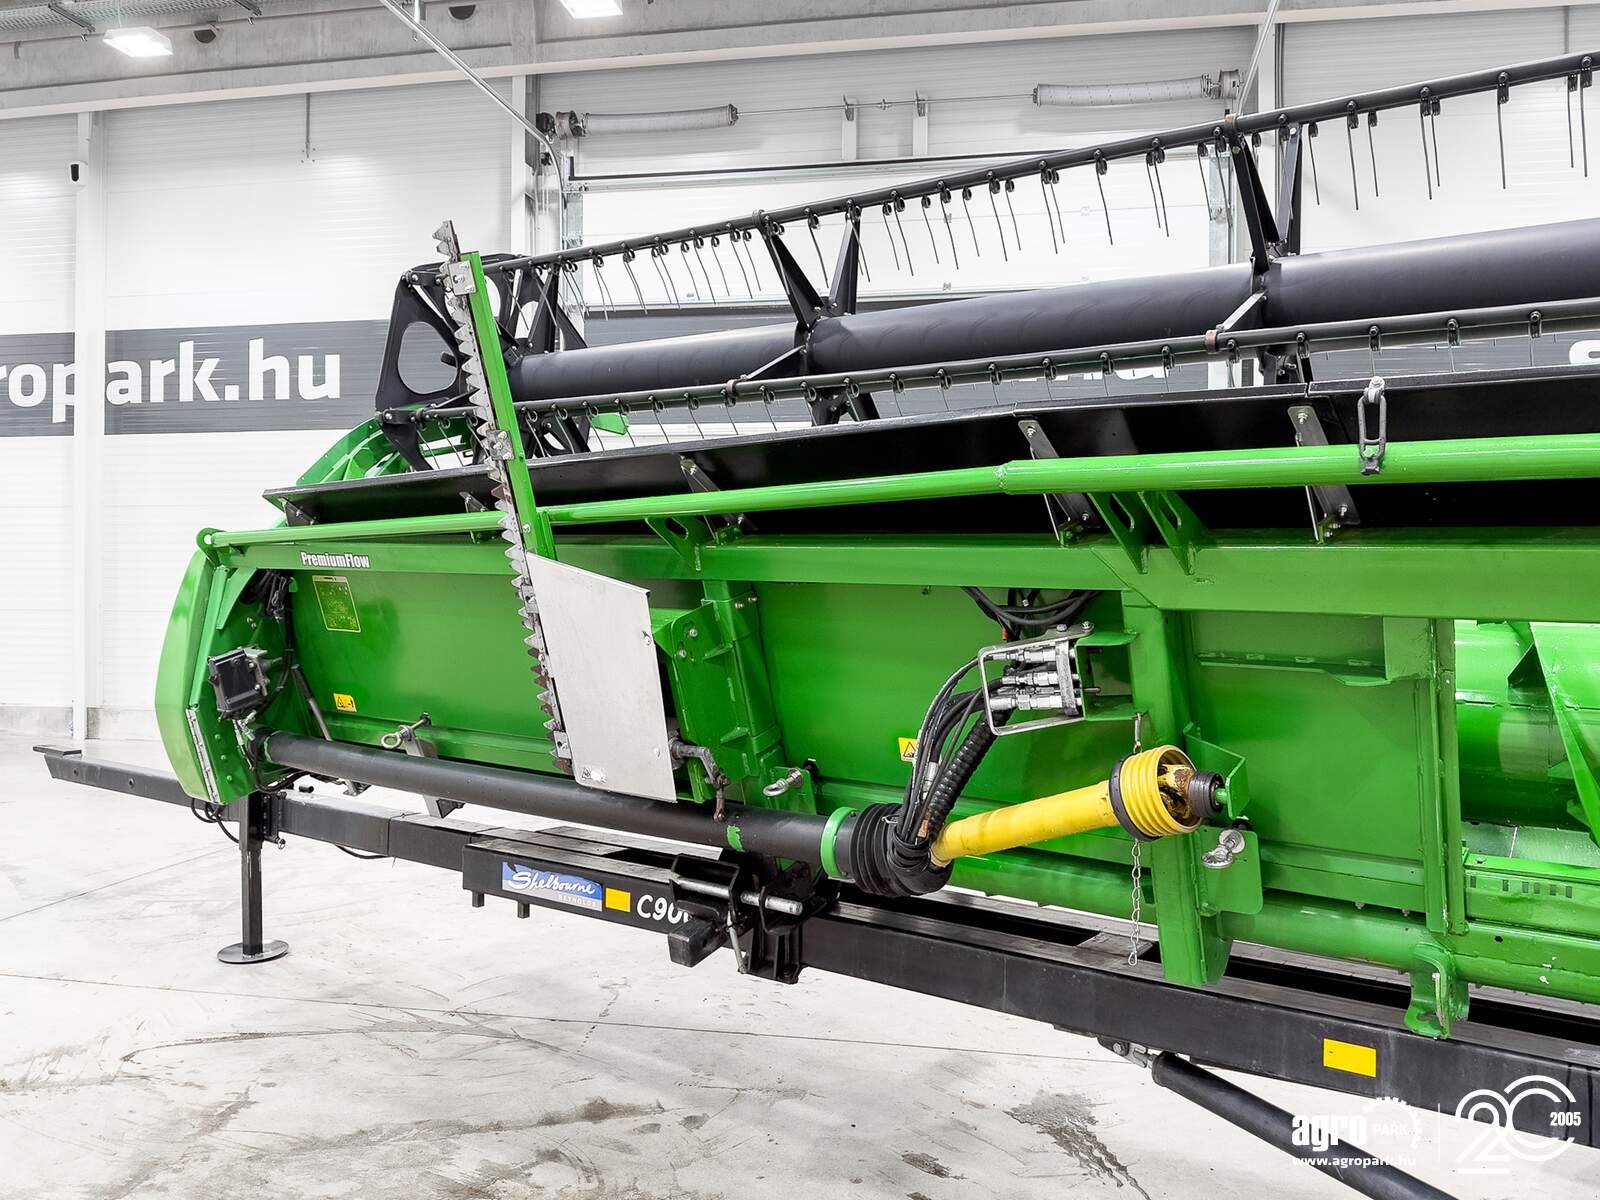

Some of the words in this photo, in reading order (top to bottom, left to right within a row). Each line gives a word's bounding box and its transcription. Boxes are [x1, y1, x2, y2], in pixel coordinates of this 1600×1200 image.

[301, 551, 370, 569] PremiumFlow
[508, 871, 596, 895] Shelbourne
[636, 894, 690, 925] C90
